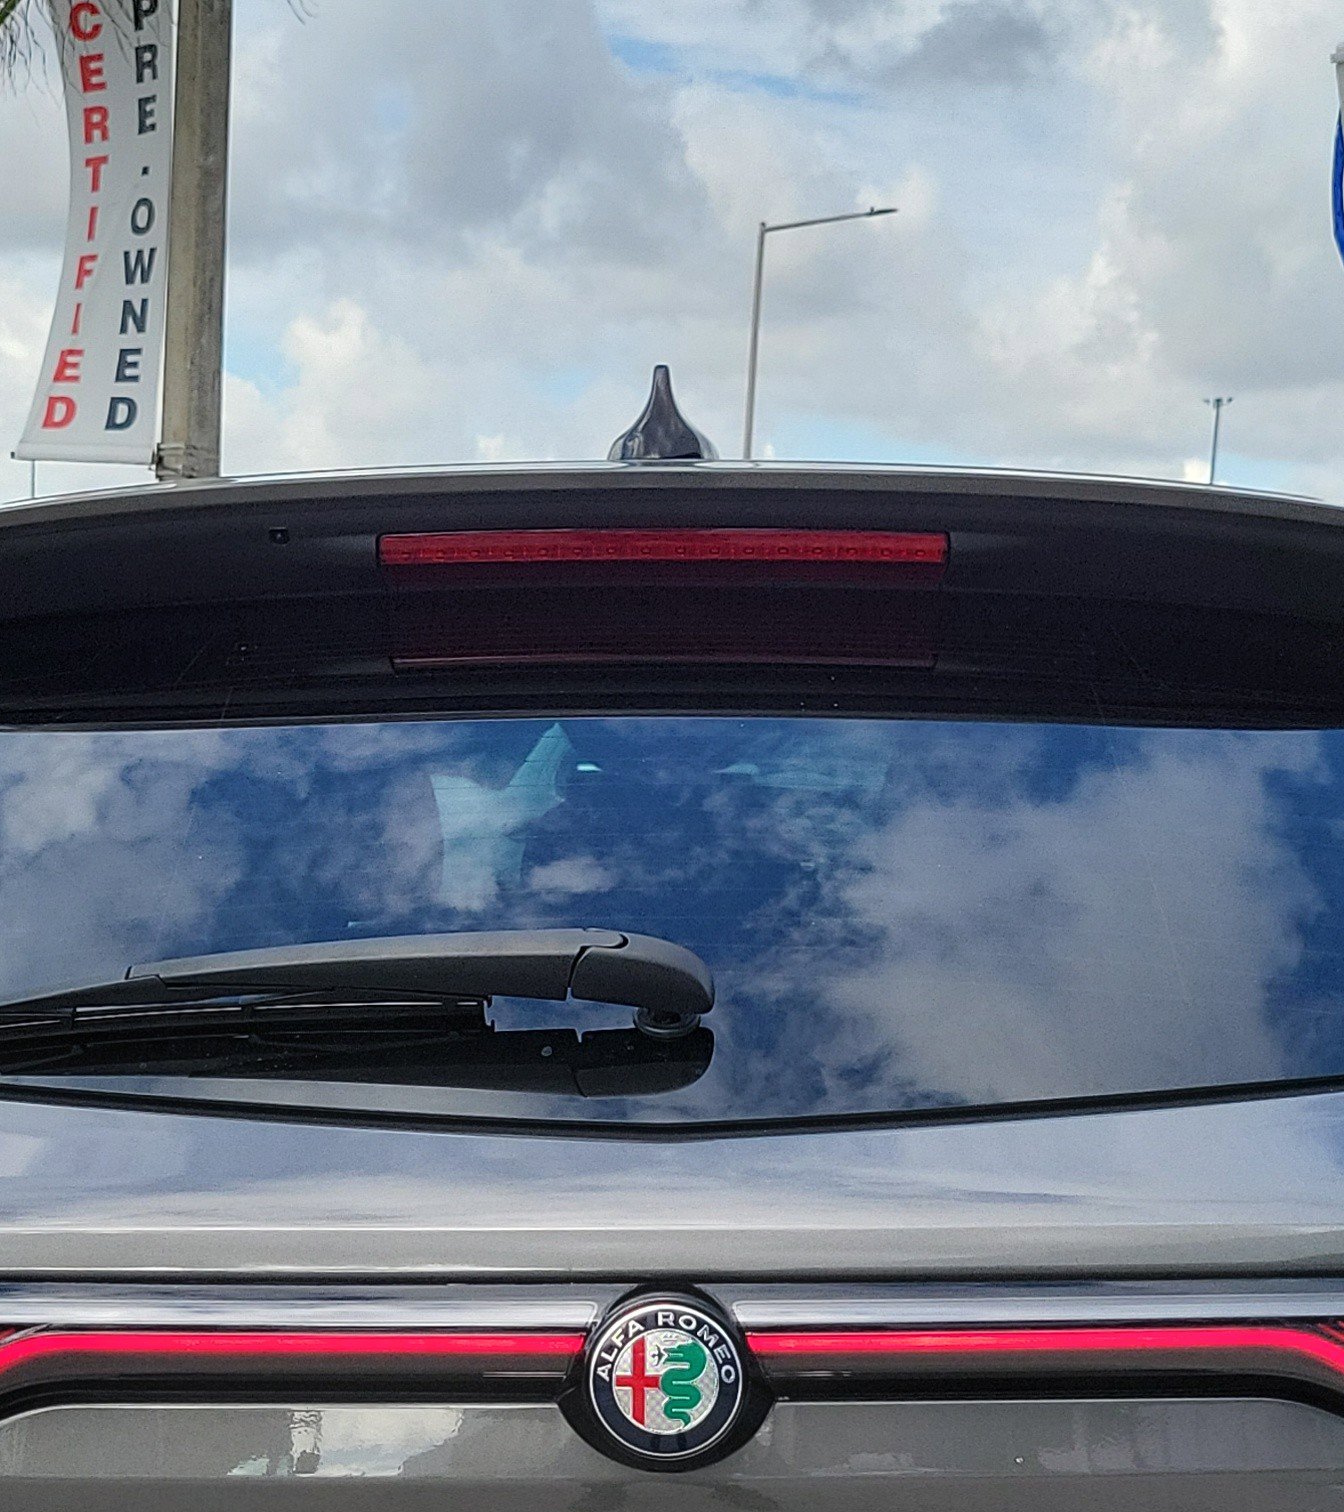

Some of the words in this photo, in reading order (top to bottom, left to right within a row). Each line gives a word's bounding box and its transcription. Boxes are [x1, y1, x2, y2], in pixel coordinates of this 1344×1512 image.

[41, 2, 109, 430] CERTIFIED
[595, 1318, 645, 1383] ALFA
[656, 1310, 737, 1385] ROMEO
